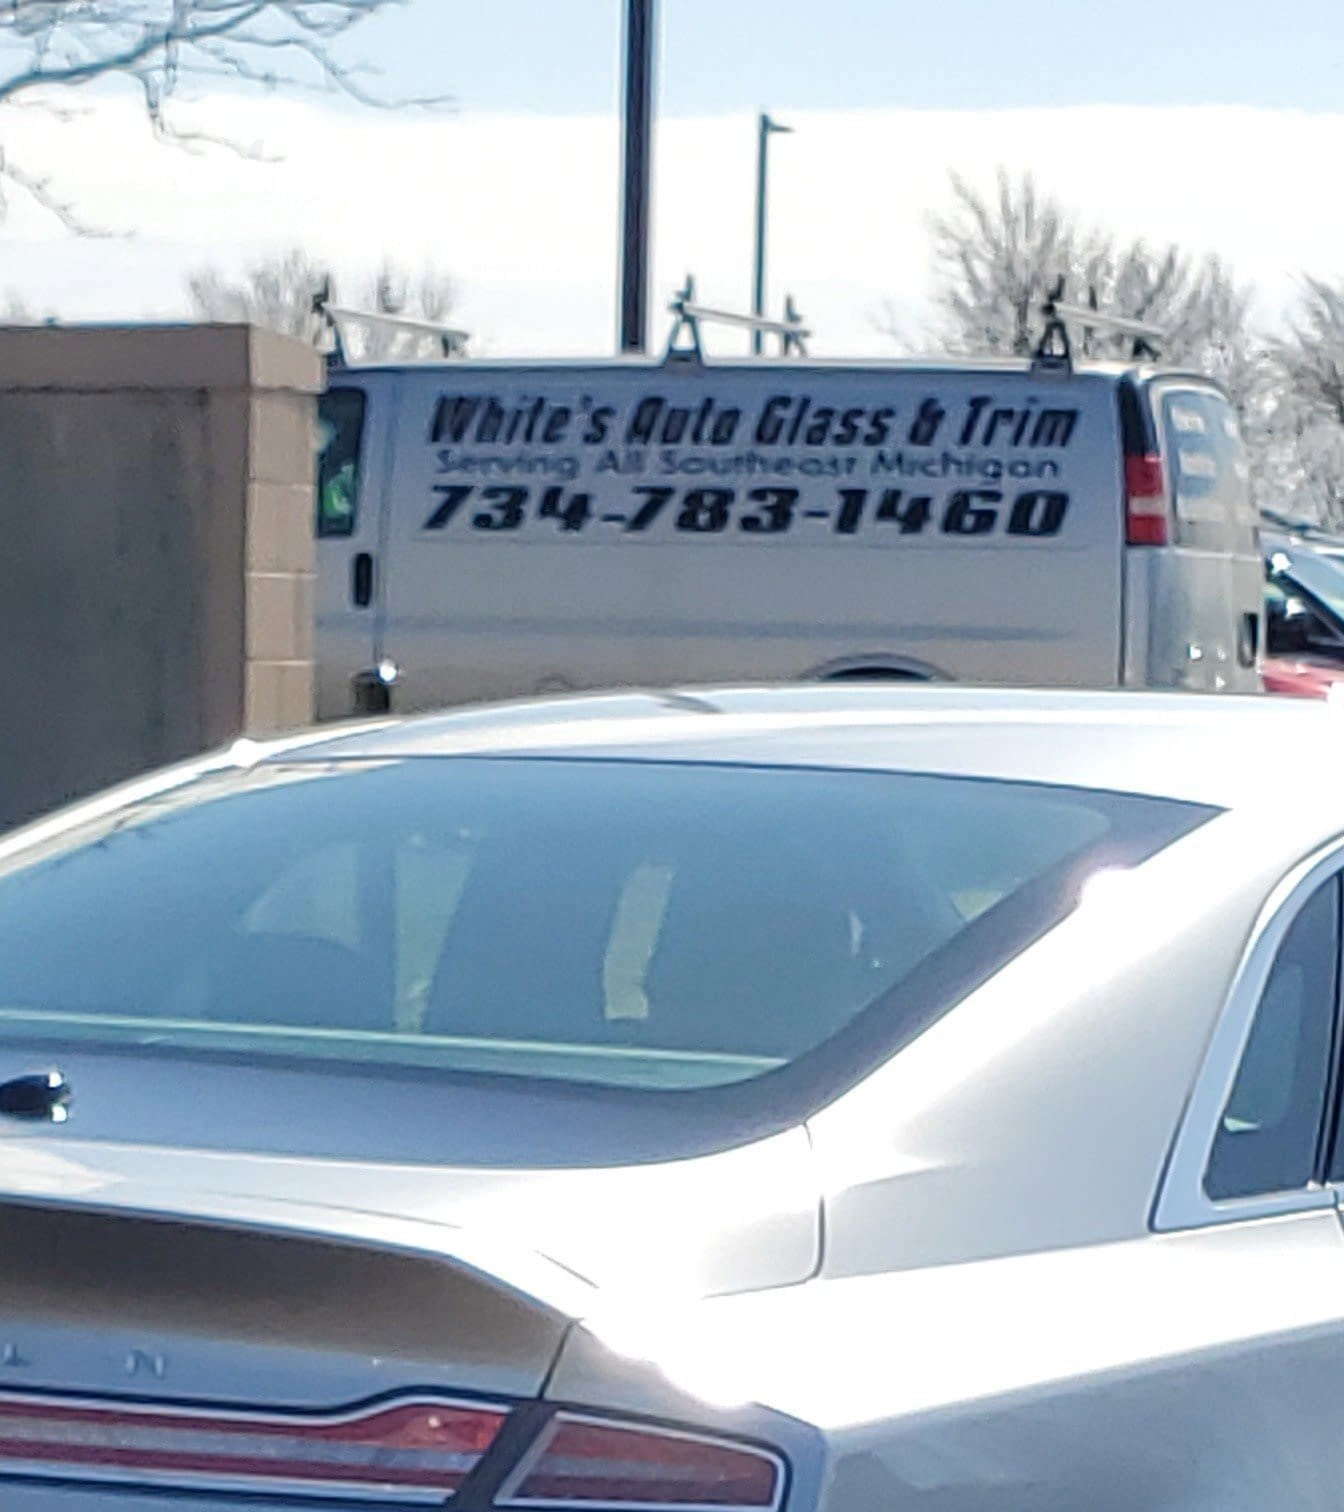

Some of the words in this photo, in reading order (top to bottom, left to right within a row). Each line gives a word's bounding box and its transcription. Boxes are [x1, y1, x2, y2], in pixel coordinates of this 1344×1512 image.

[429, 395, 617, 445] White's
[627, 395, 743, 446] Auto
[754, 396, 898, 447] Glass
[908, 397, 948, 447] &
[958, 397, 1080, 448] Trim
[435, 448, 580, 481] Serving
[594, 448, 647, 475] All
[657, 449, 858, 477] Southeast
[869, 451, 1059, 486] Michigan
[421, 484, 1073, 537] 734-783-1460
